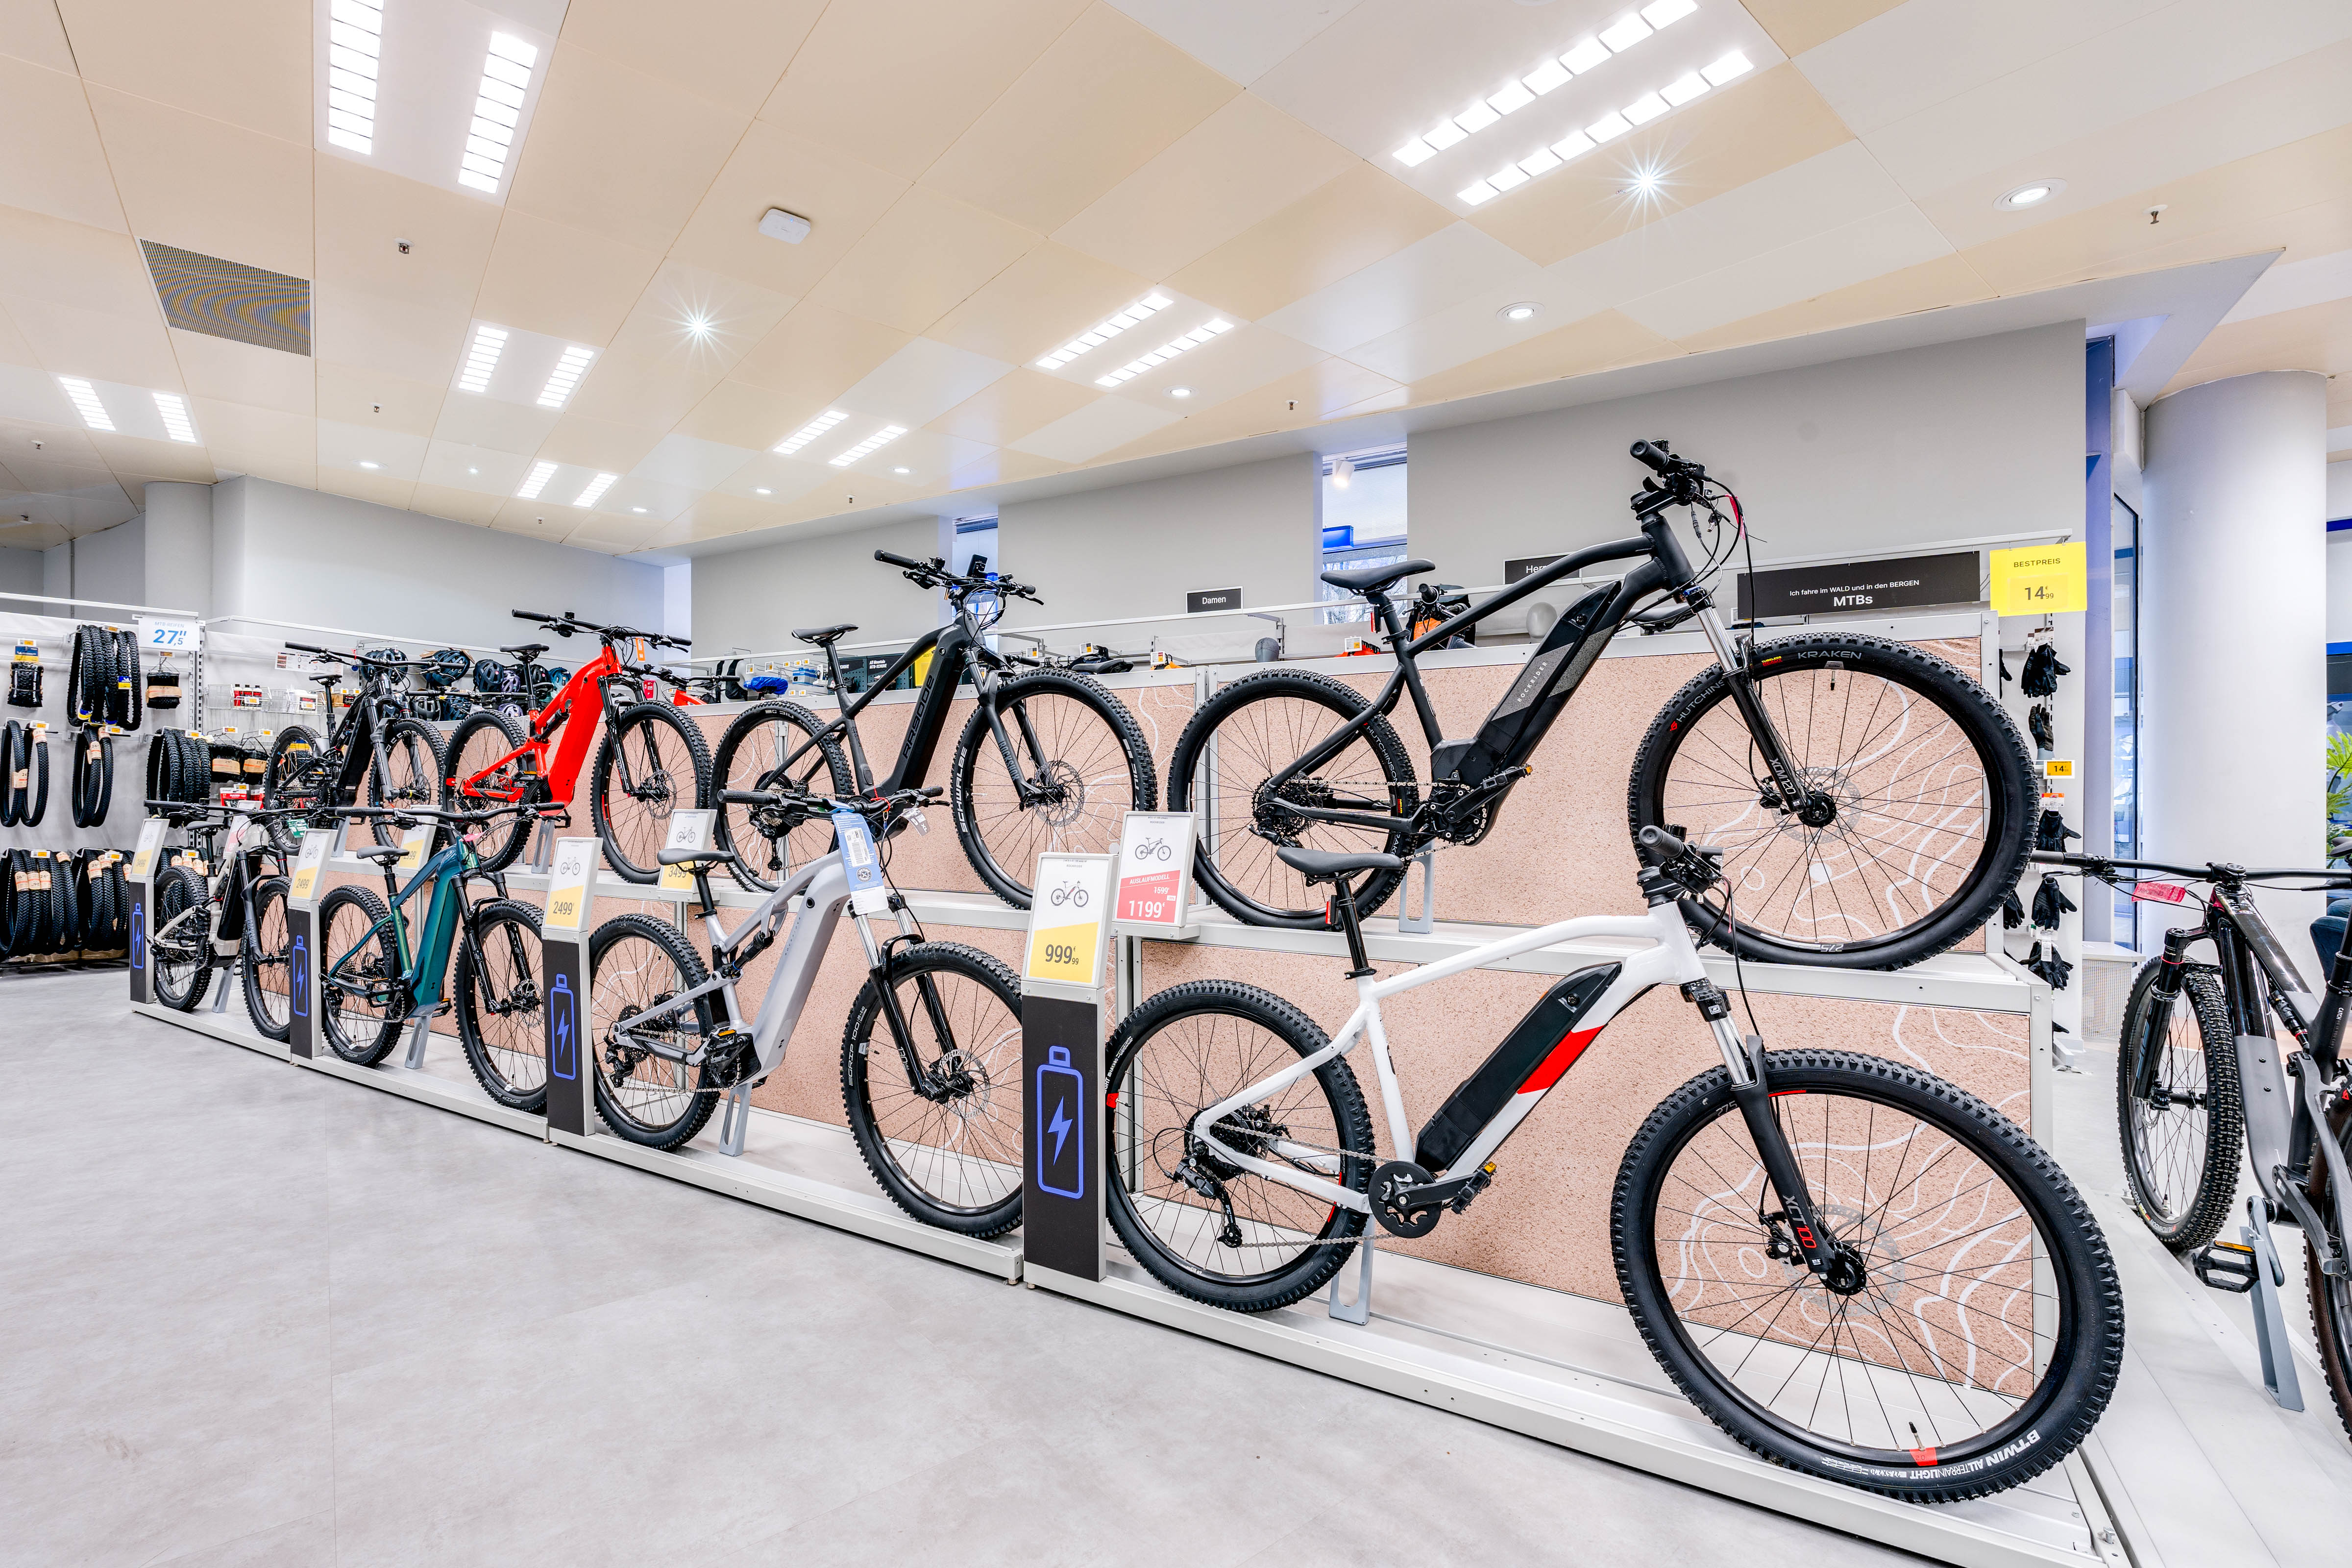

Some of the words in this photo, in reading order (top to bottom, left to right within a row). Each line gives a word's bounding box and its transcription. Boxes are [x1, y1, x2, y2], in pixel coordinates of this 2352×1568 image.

[2013, 558, 2061, 567] BESTPREIS
[1834, 594, 1873, 607] MTBs
[1798, 650, 1862, 660] KRAKEN
[1517, 662, 1548, 702] ROCKRIDER
[1676, 680, 1724, 722] HUTCHINS
[999, 740, 1021, 782] ROCKSHOX
[956, 746, 968, 833] SCHWALBE
[1129, 874, 1170, 884] AUSLAUFMODELL
[2336, 1007, 2344, 1020] CATCH
[852, 1022, 860, 1041] 100
[1783, 1195, 1807, 1225] XCT
[1796, 1225, 1817, 1249] 100
[1986, 1429, 2041, 1467] B'TWIN
